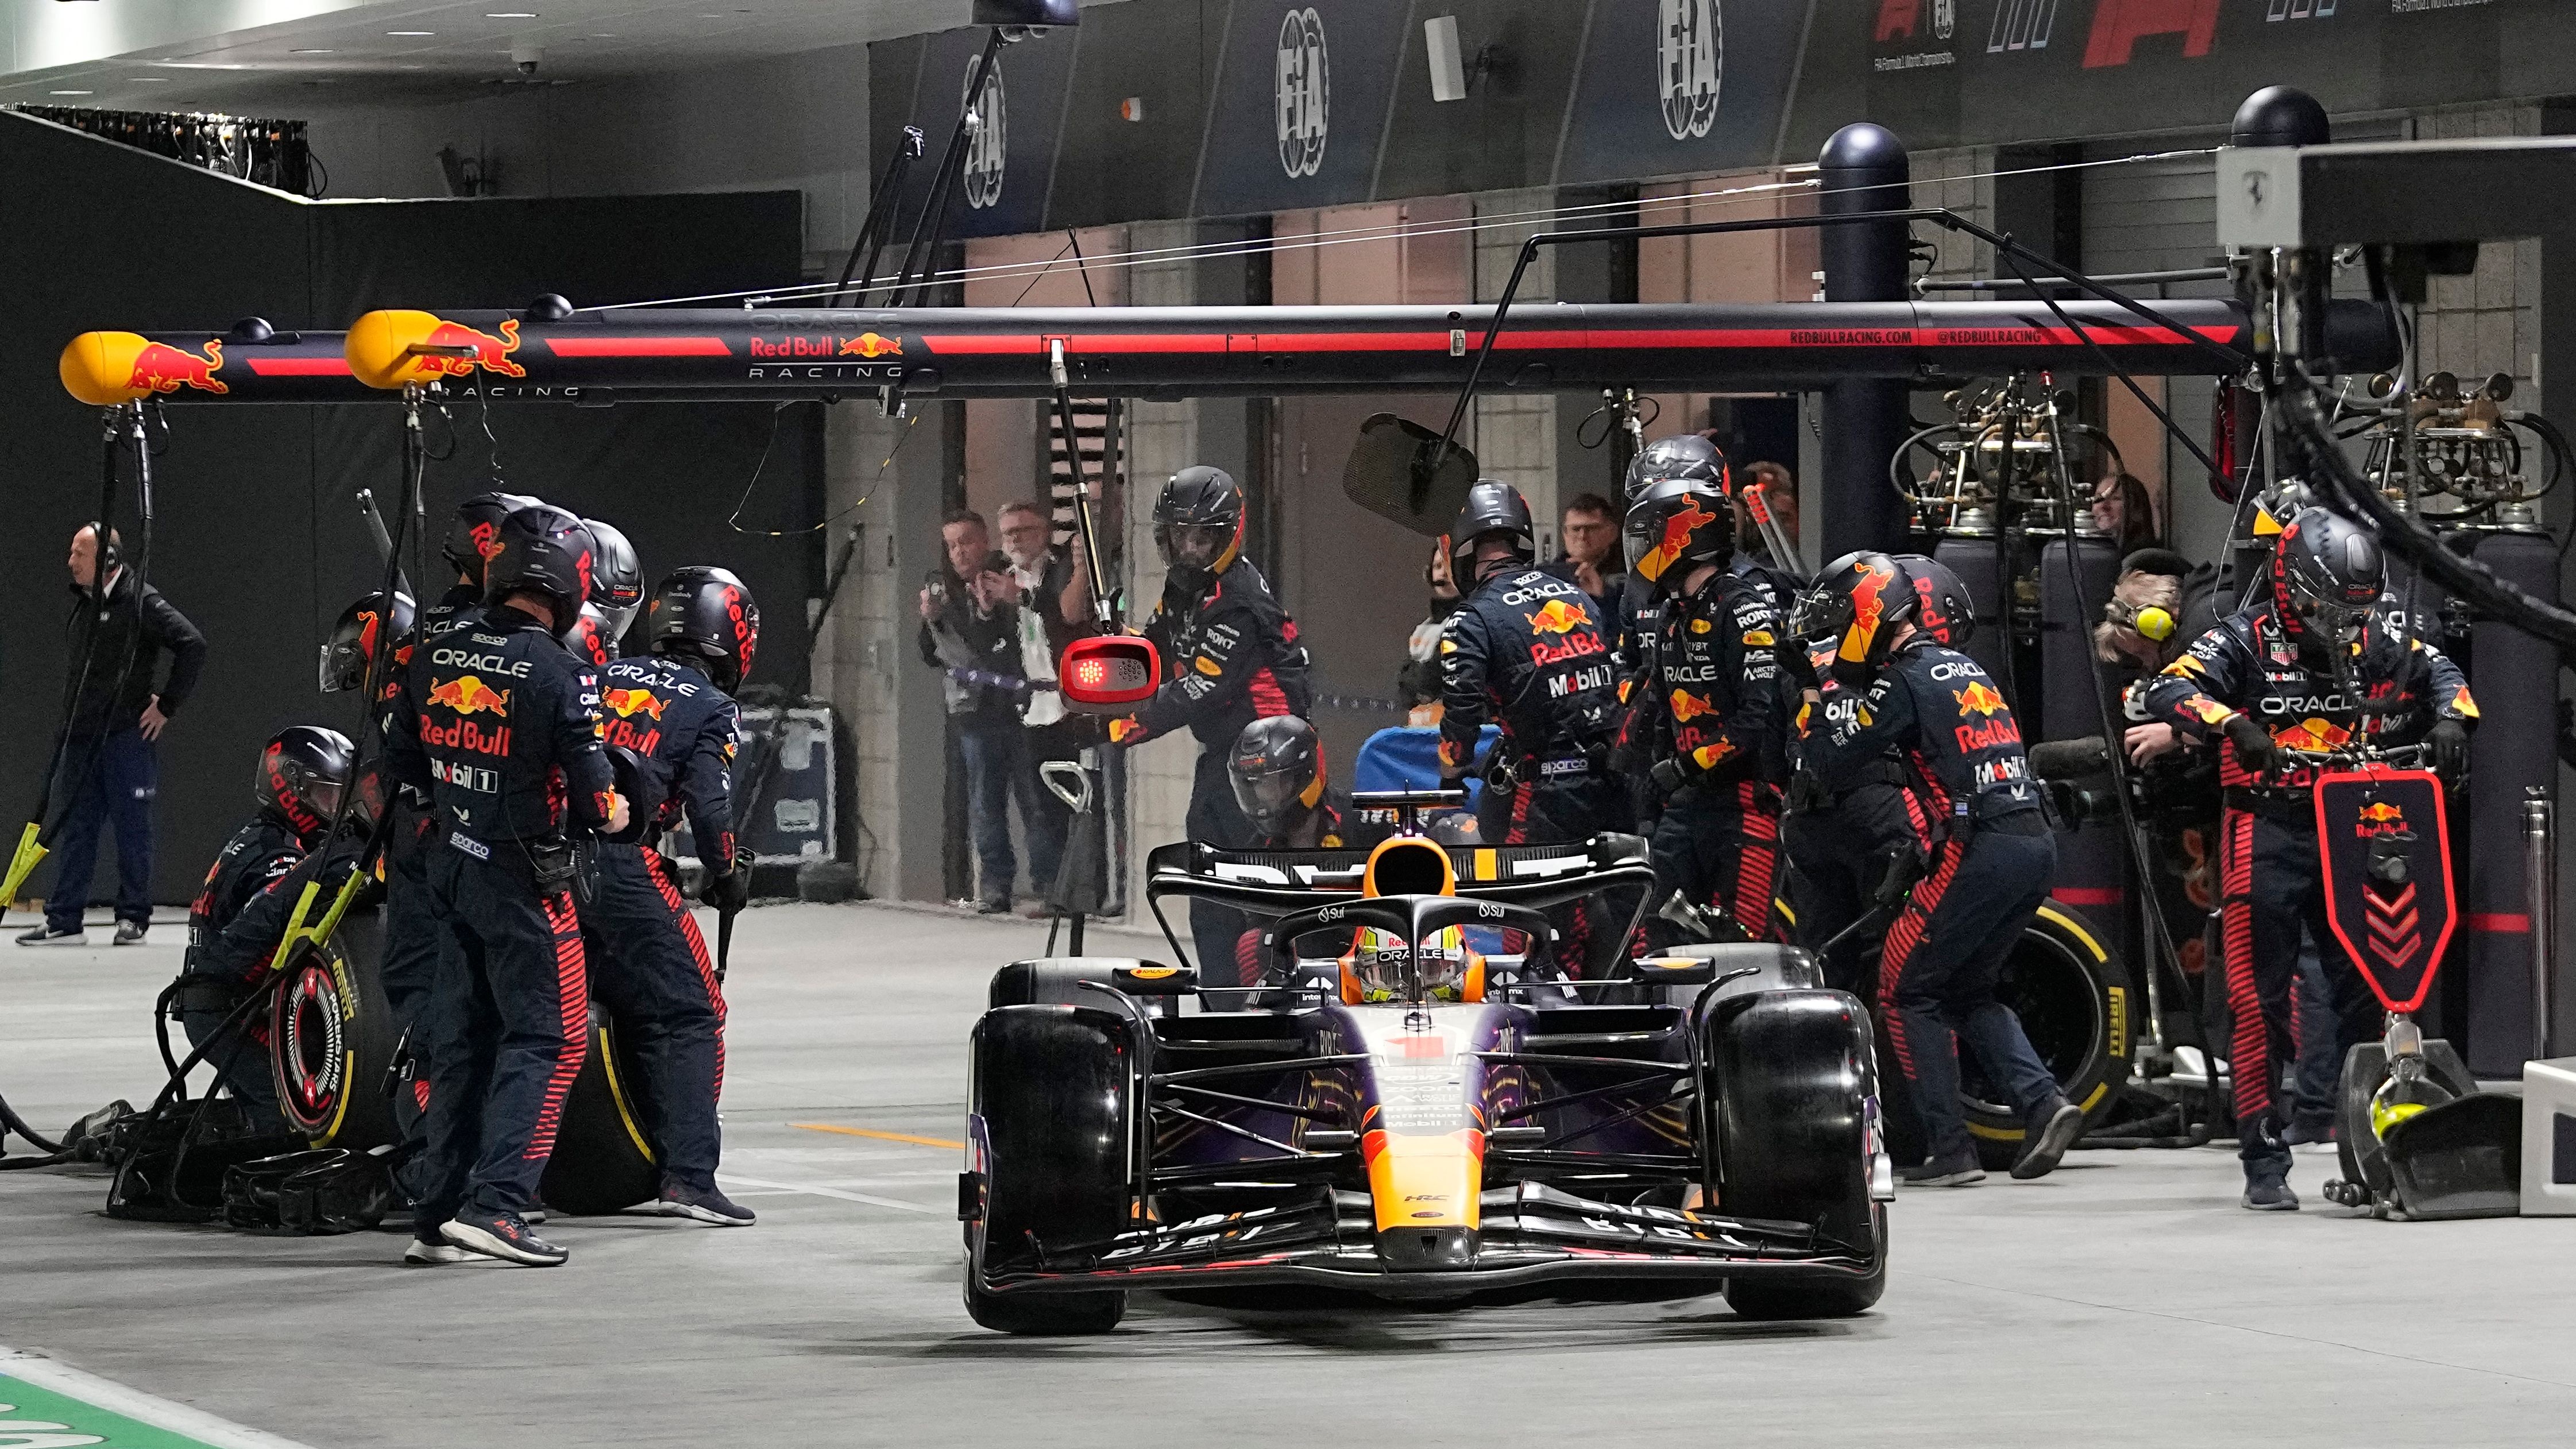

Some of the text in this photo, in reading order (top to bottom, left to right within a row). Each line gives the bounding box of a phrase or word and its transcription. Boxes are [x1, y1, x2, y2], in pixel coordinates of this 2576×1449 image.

[750, 336, 833, 357] Red Bull
[1790, 331, 1912, 344] REDBULLRACING.COM
[1937, 330, 2042, 345] @REDBULLRACING
[748, 367, 902, 378] RACING
[1502, 584, 1578, 605] ORACLE
[1736, 609, 1772, 628] ROKT
[2272, 644, 2295, 652] TAG
[432, 648, 534, 679] ORACLE
[1662, 664, 1718, 682] RACLE
[1930, 662, 1987, 681] ORACL
[607, 664, 700, 697] ORACLE
[1548, 666, 1601, 698] Mobil
[2265, 671, 2295, 682] Mobil
[580, 692, 600, 705] Clar
[2260, 694, 2353, 714] ORACL
[420, 714, 512, 758] Red Bull
[613, 720, 661, 758] Bull
[1955, 719, 1998, 754] Red
[430, 757, 473, 791] Mobil
[1540, 759, 1588, 774] sparco
[1975, 756, 2021, 785] Mobil
[451, 831, 490, 858] sparco
[269, 856, 296, 868] Mobil
[1330, 907, 1345, 919] Sui
[1489, 905, 1505, 918] Sui
[328, 992, 342, 1092] POKERSTARS
